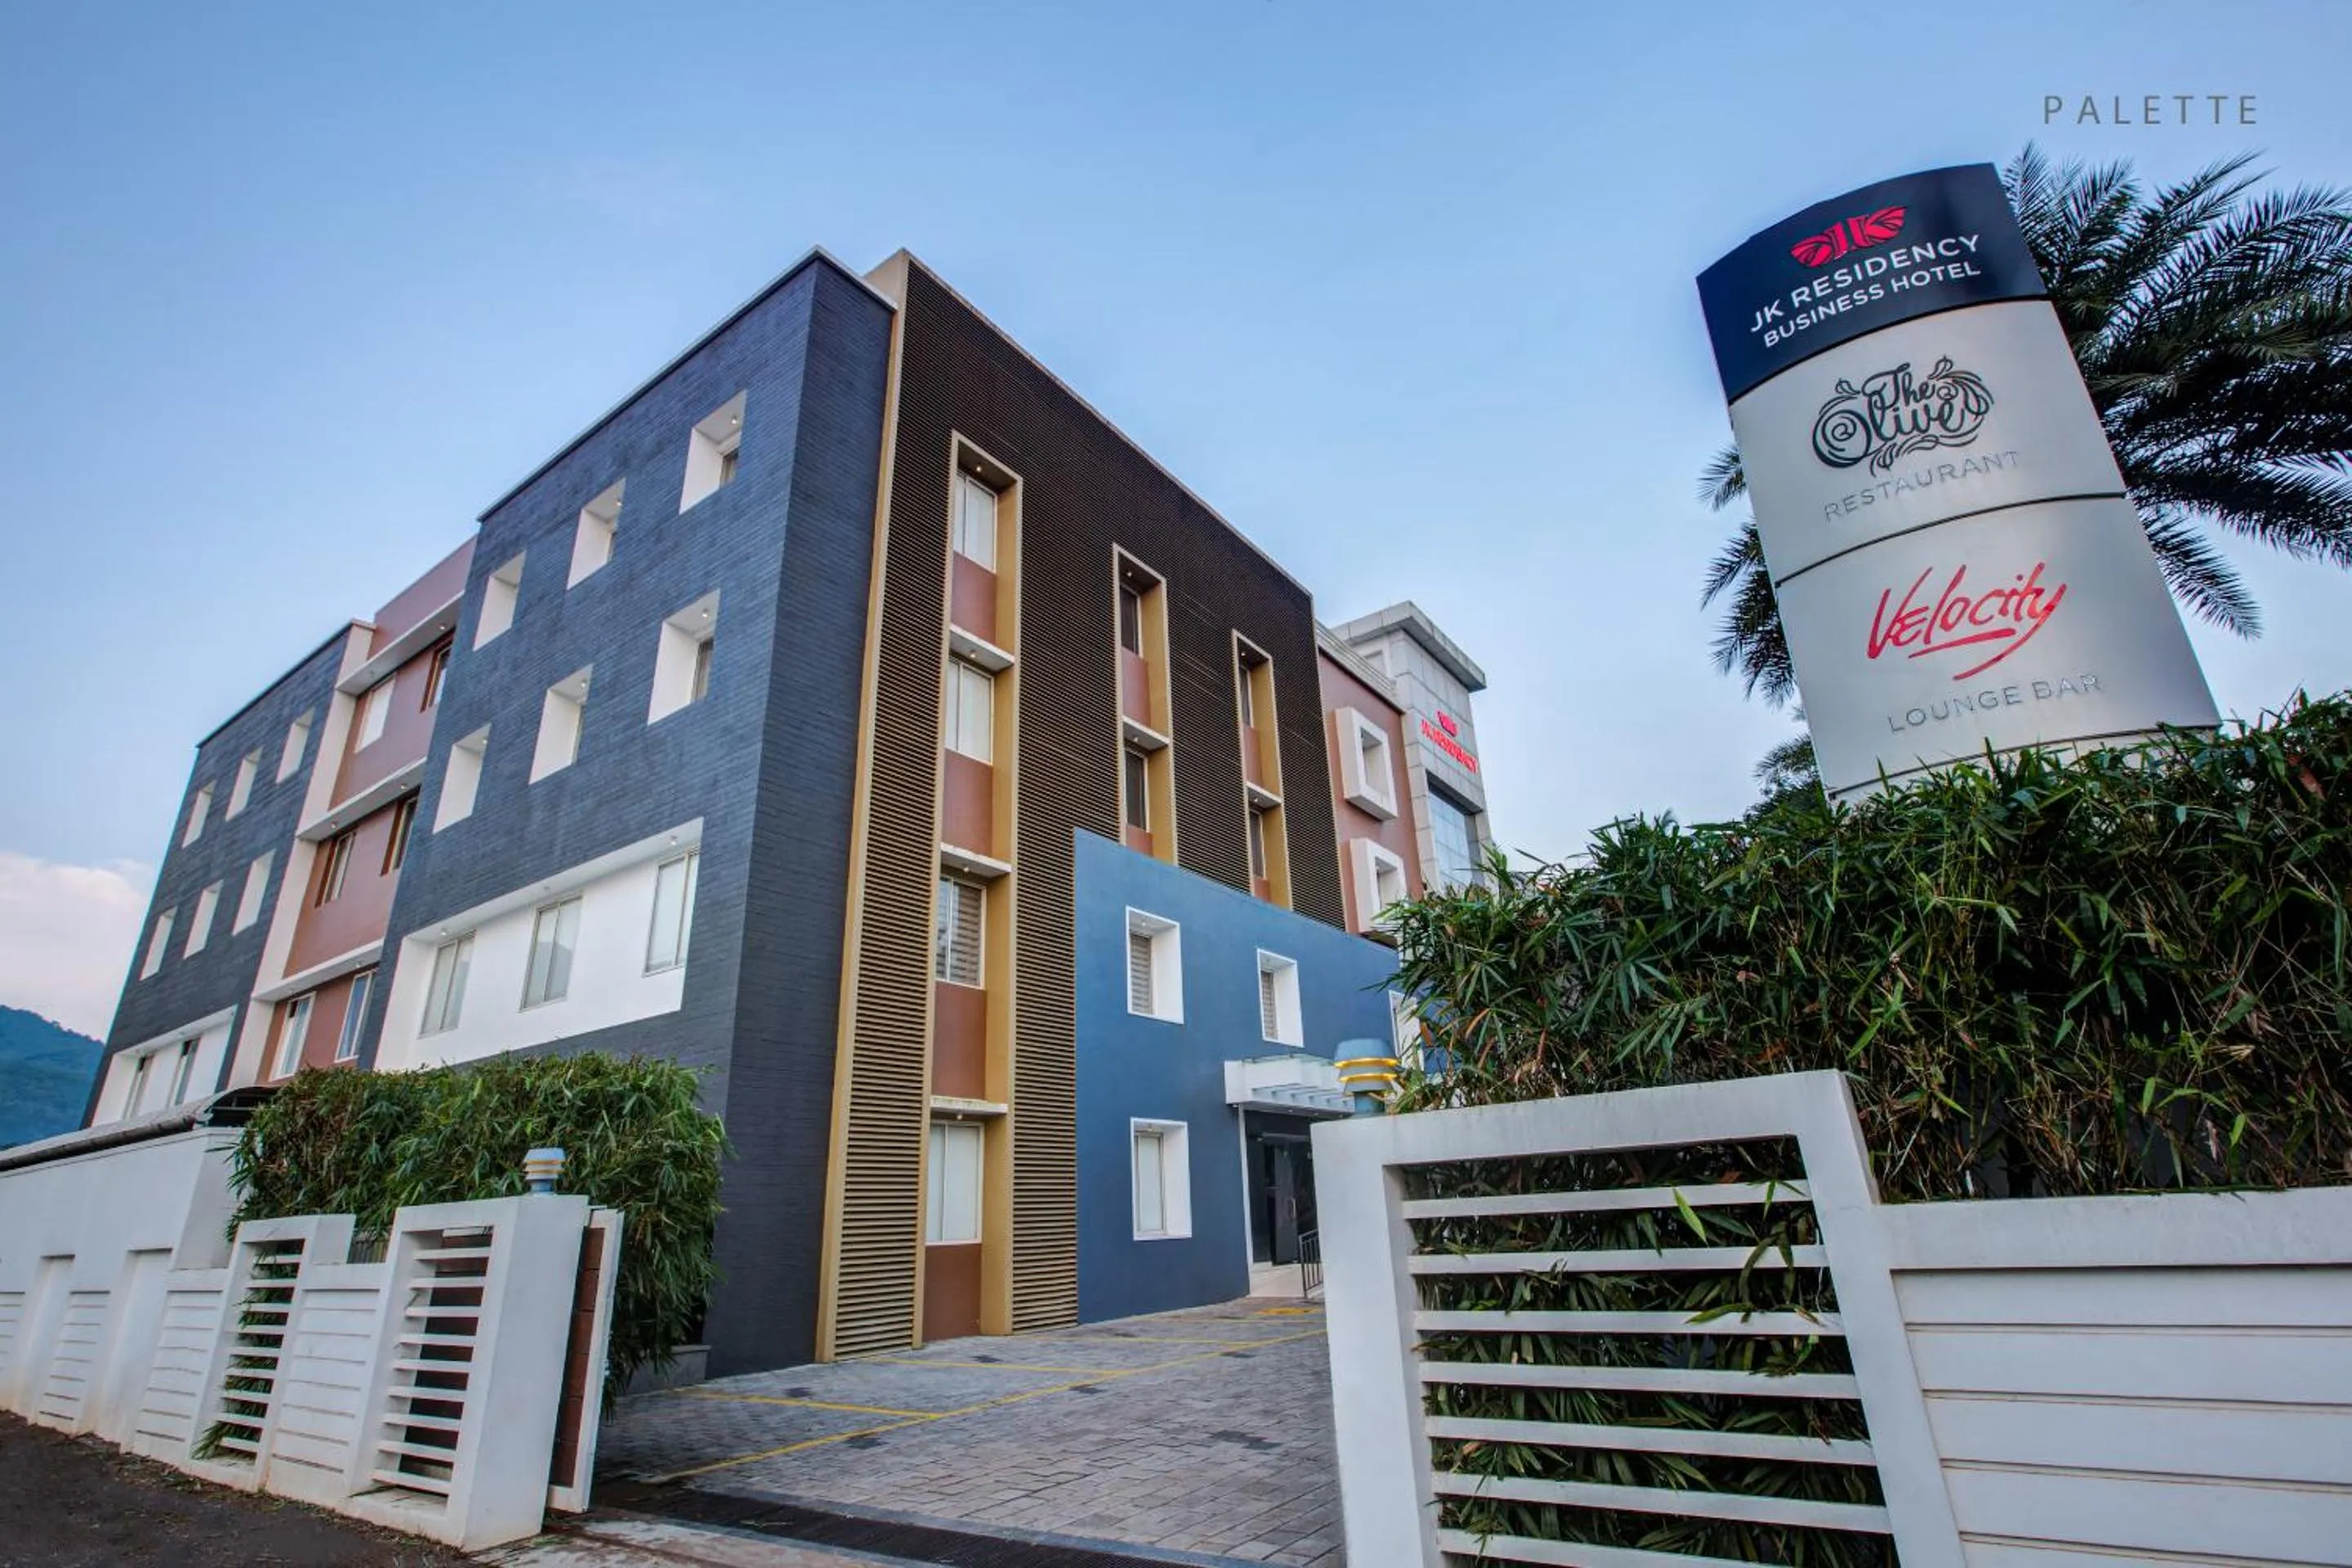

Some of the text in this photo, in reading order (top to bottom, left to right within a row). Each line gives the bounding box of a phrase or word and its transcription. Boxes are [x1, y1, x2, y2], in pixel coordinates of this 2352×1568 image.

[1750, 234, 1980, 332] JK RESIDENCY
[1764, 261, 1981, 348] BUSINESS HOTEL
[1861, 362, 1935, 410] The
[1812, 392, 1970, 469] Olive
[1823, 450, 2020, 523] RESTAURANT
[1887, 674, 2105, 733] LOUNGE BAR
